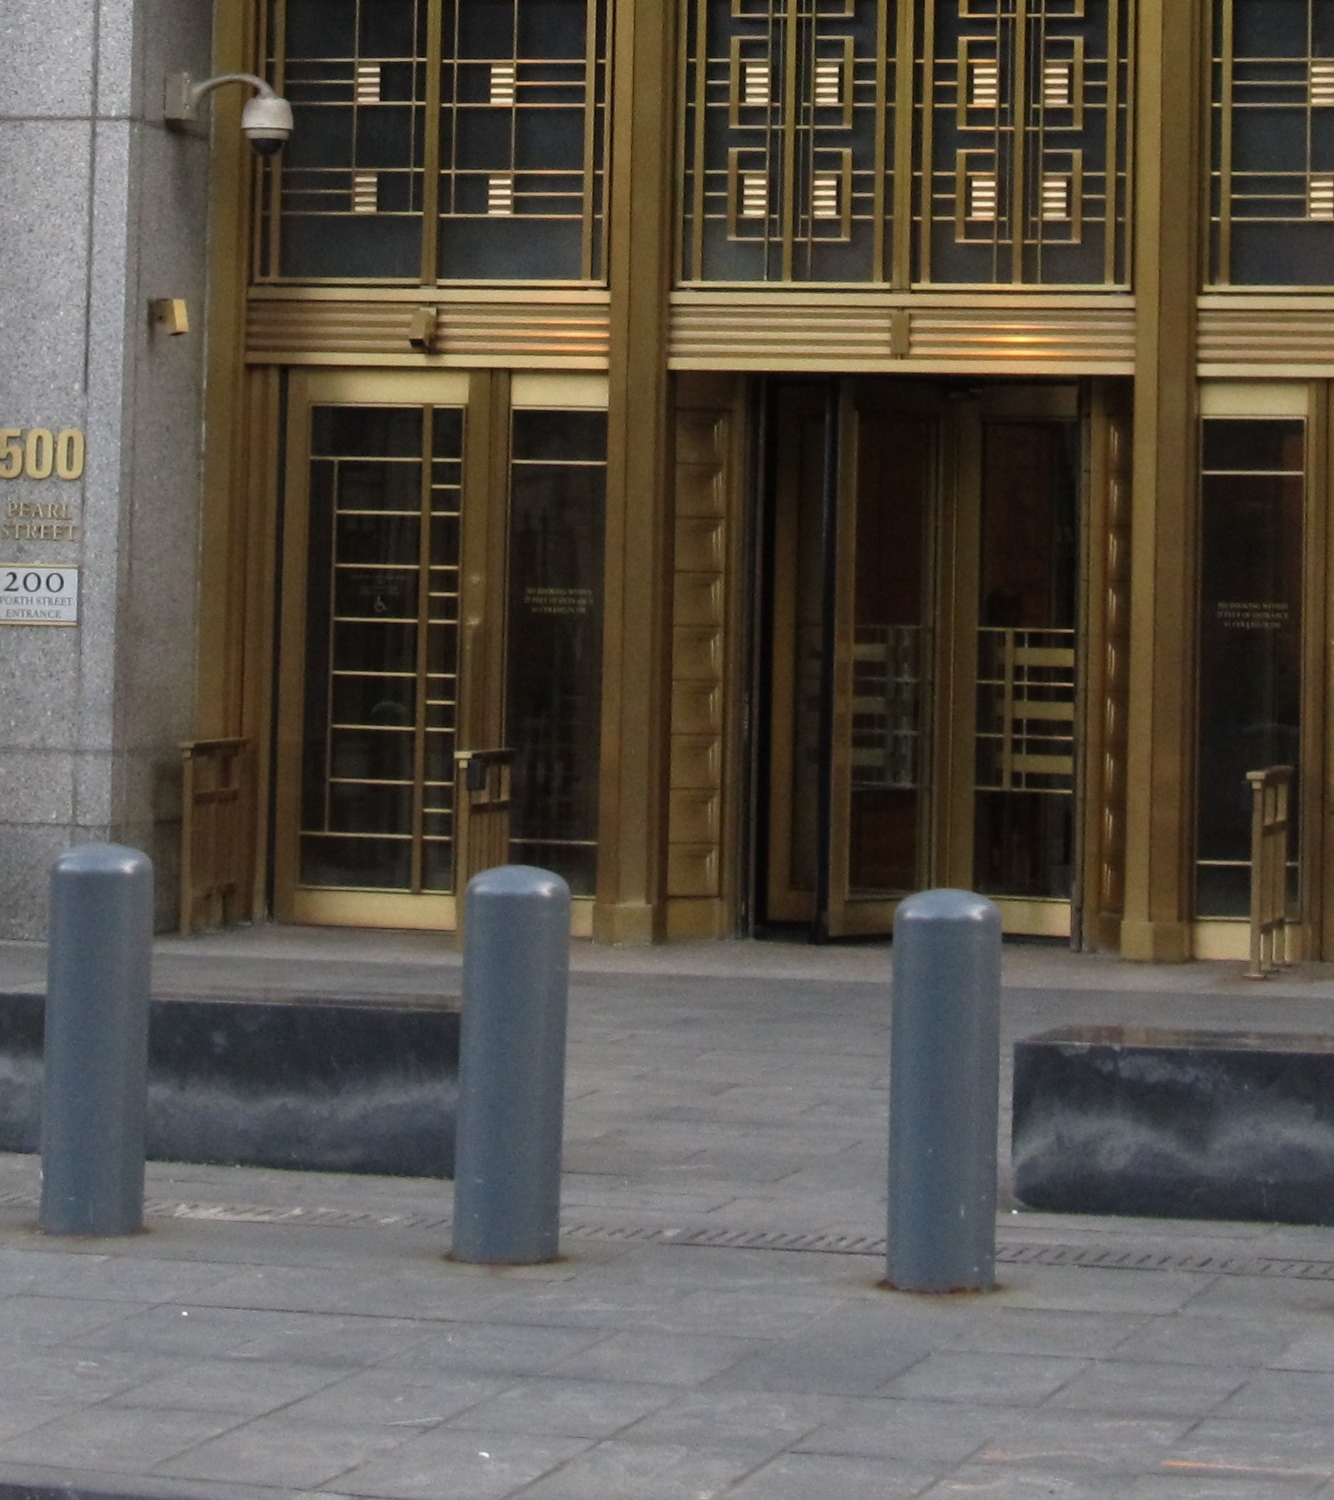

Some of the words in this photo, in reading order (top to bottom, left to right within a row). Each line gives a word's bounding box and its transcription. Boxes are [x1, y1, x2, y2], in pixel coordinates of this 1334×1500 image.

[7, 501, 72, 520] PEARL
[1, 523, 76, 541] STREET
[3, 571, 65, 593] 200
[36, 596, 73, 607] STREET
[5, 609, 62, 619] ENTRANCE
